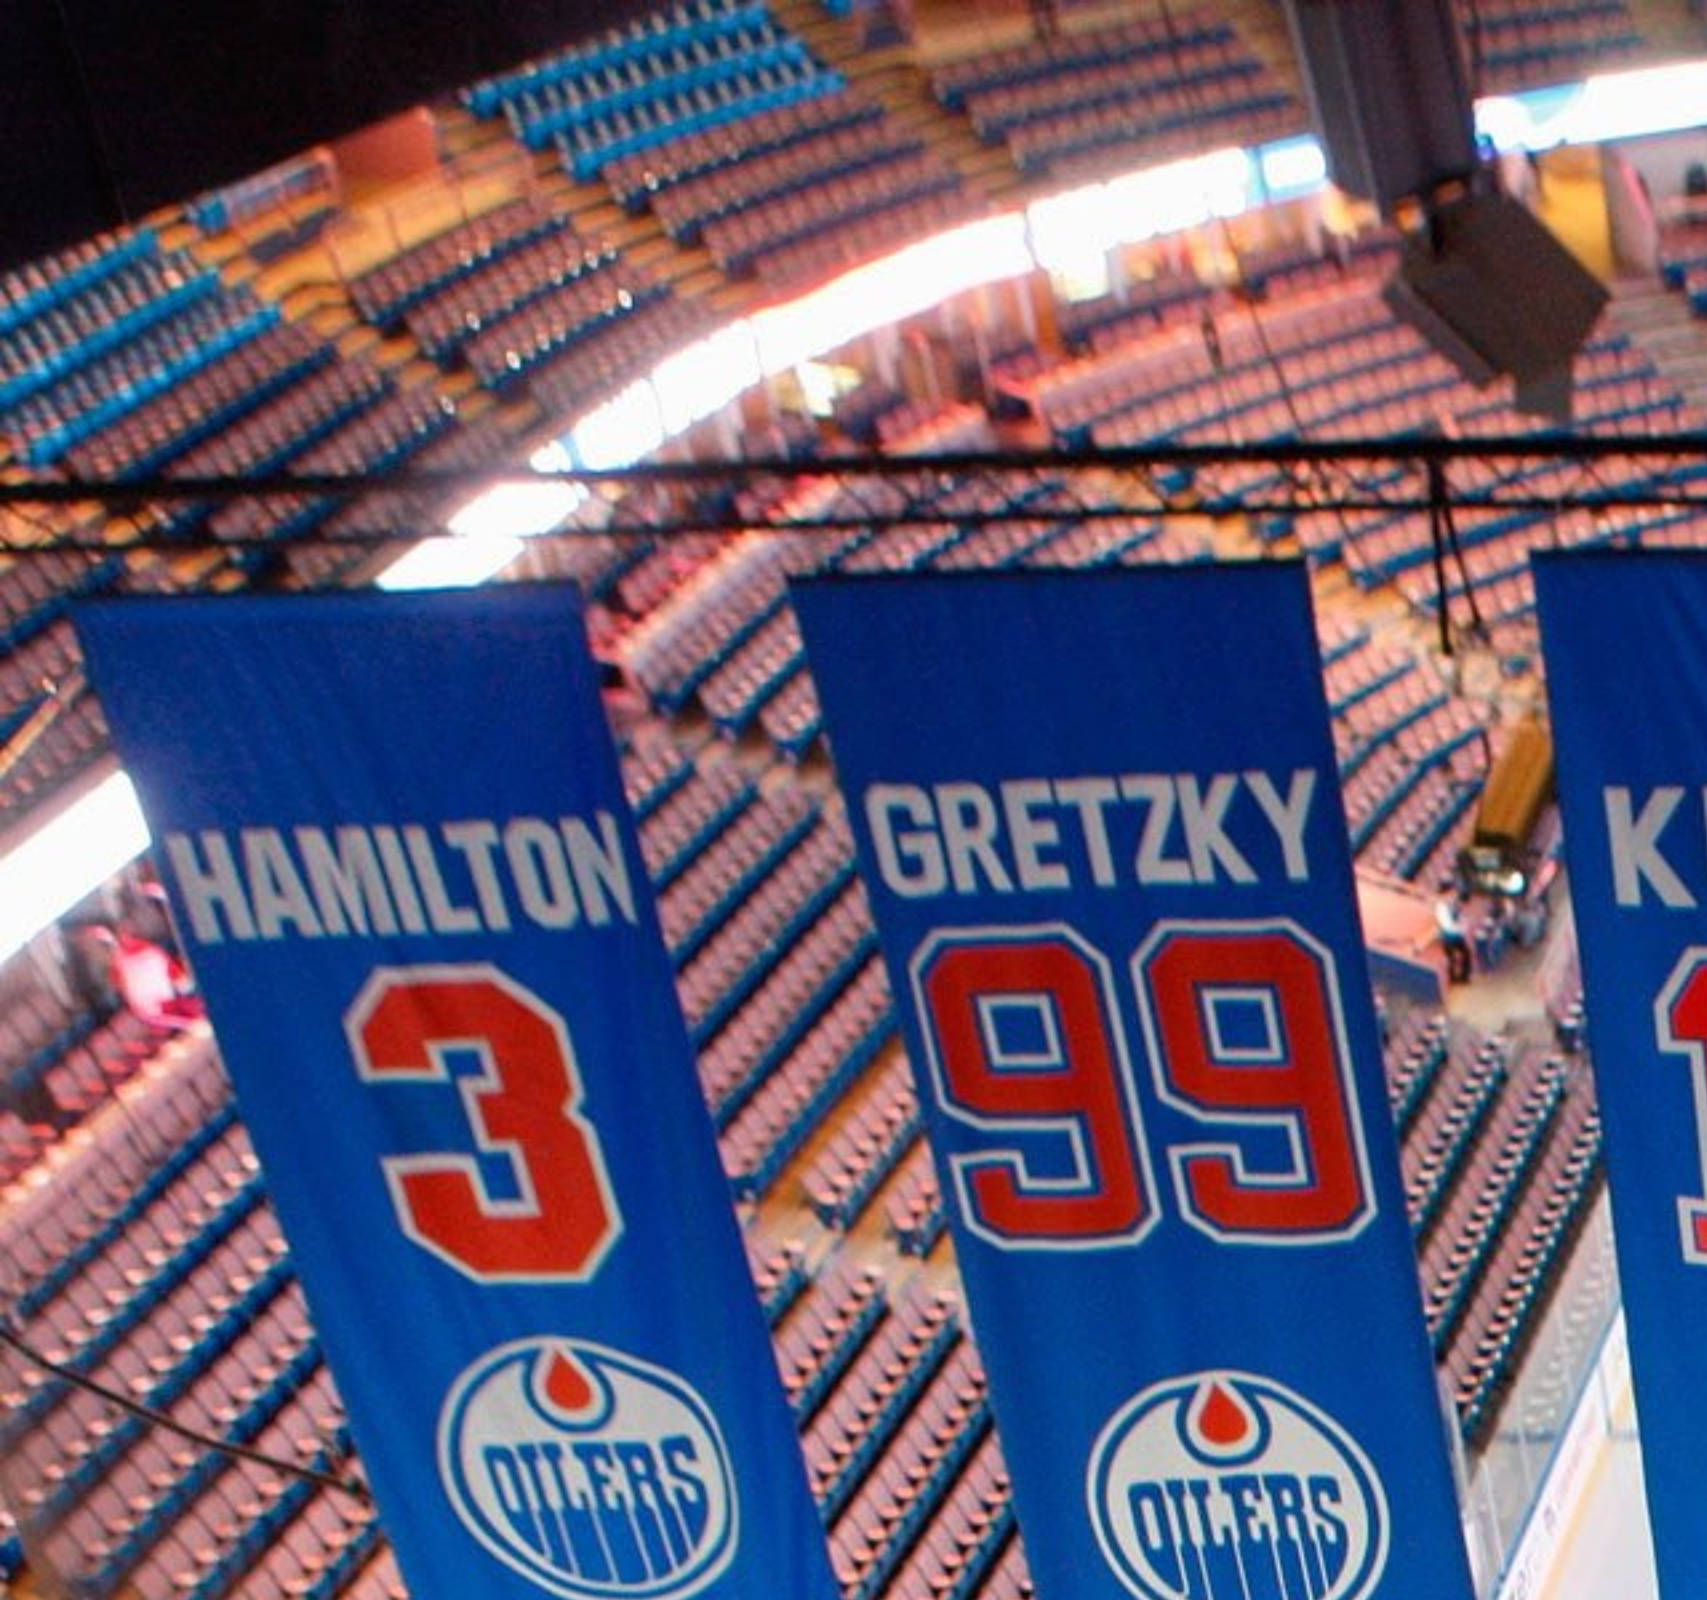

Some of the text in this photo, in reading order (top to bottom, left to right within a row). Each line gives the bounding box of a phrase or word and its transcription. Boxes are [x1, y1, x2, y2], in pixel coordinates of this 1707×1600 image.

[166, 811, 638, 943] HAMILTON
[865, 768, 1317, 898] GRETZKY
[341, 963, 627, 1285] 3
[908, 917, 1378, 1252] 99
[482, 1434, 710, 1540] OILERS
[1127, 1470, 1351, 1572] OILERS
